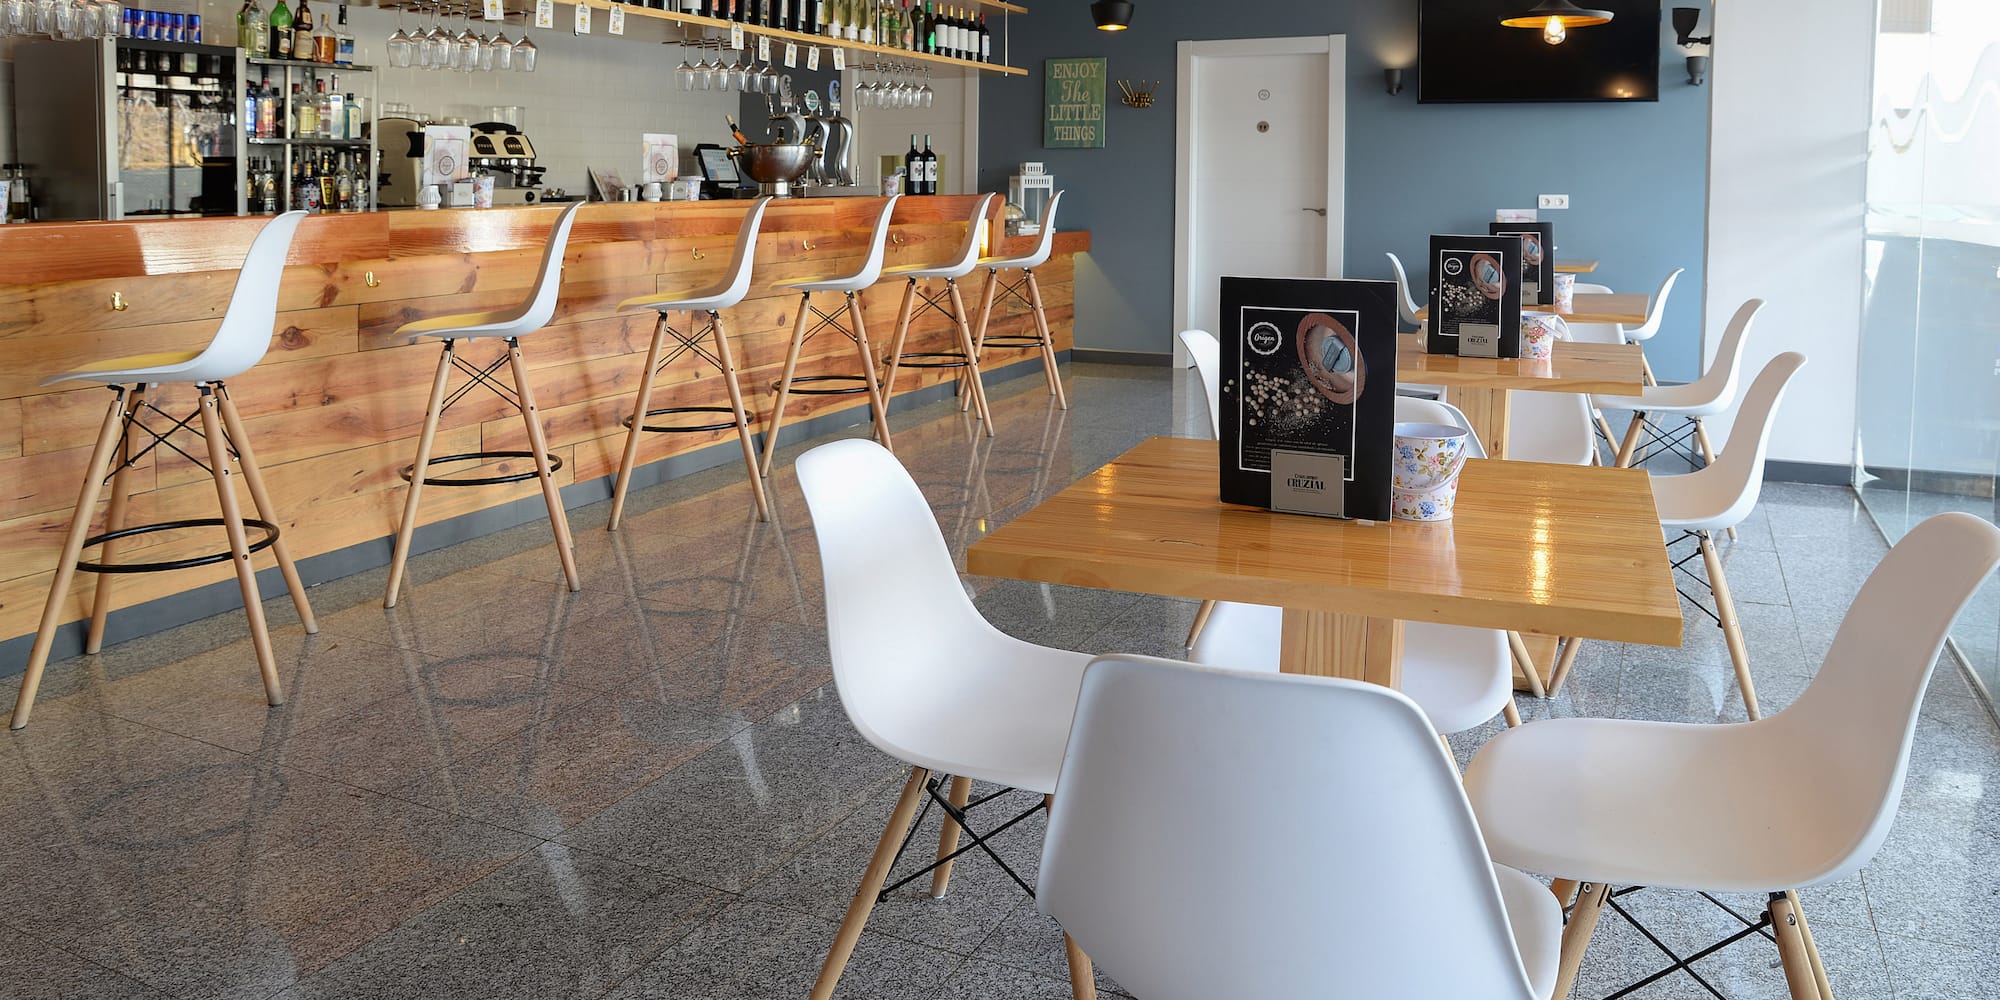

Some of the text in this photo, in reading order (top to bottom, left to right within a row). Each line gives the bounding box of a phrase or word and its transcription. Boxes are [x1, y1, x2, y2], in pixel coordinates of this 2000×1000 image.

[1053, 62, 1099, 79] ENJOY
[1061, 80, 1089, 102] The
[1049, 103, 1101, 121] LITTLE
[1054, 125, 1096, 141] THINGS
[1254, 333, 1274, 344] Origen
